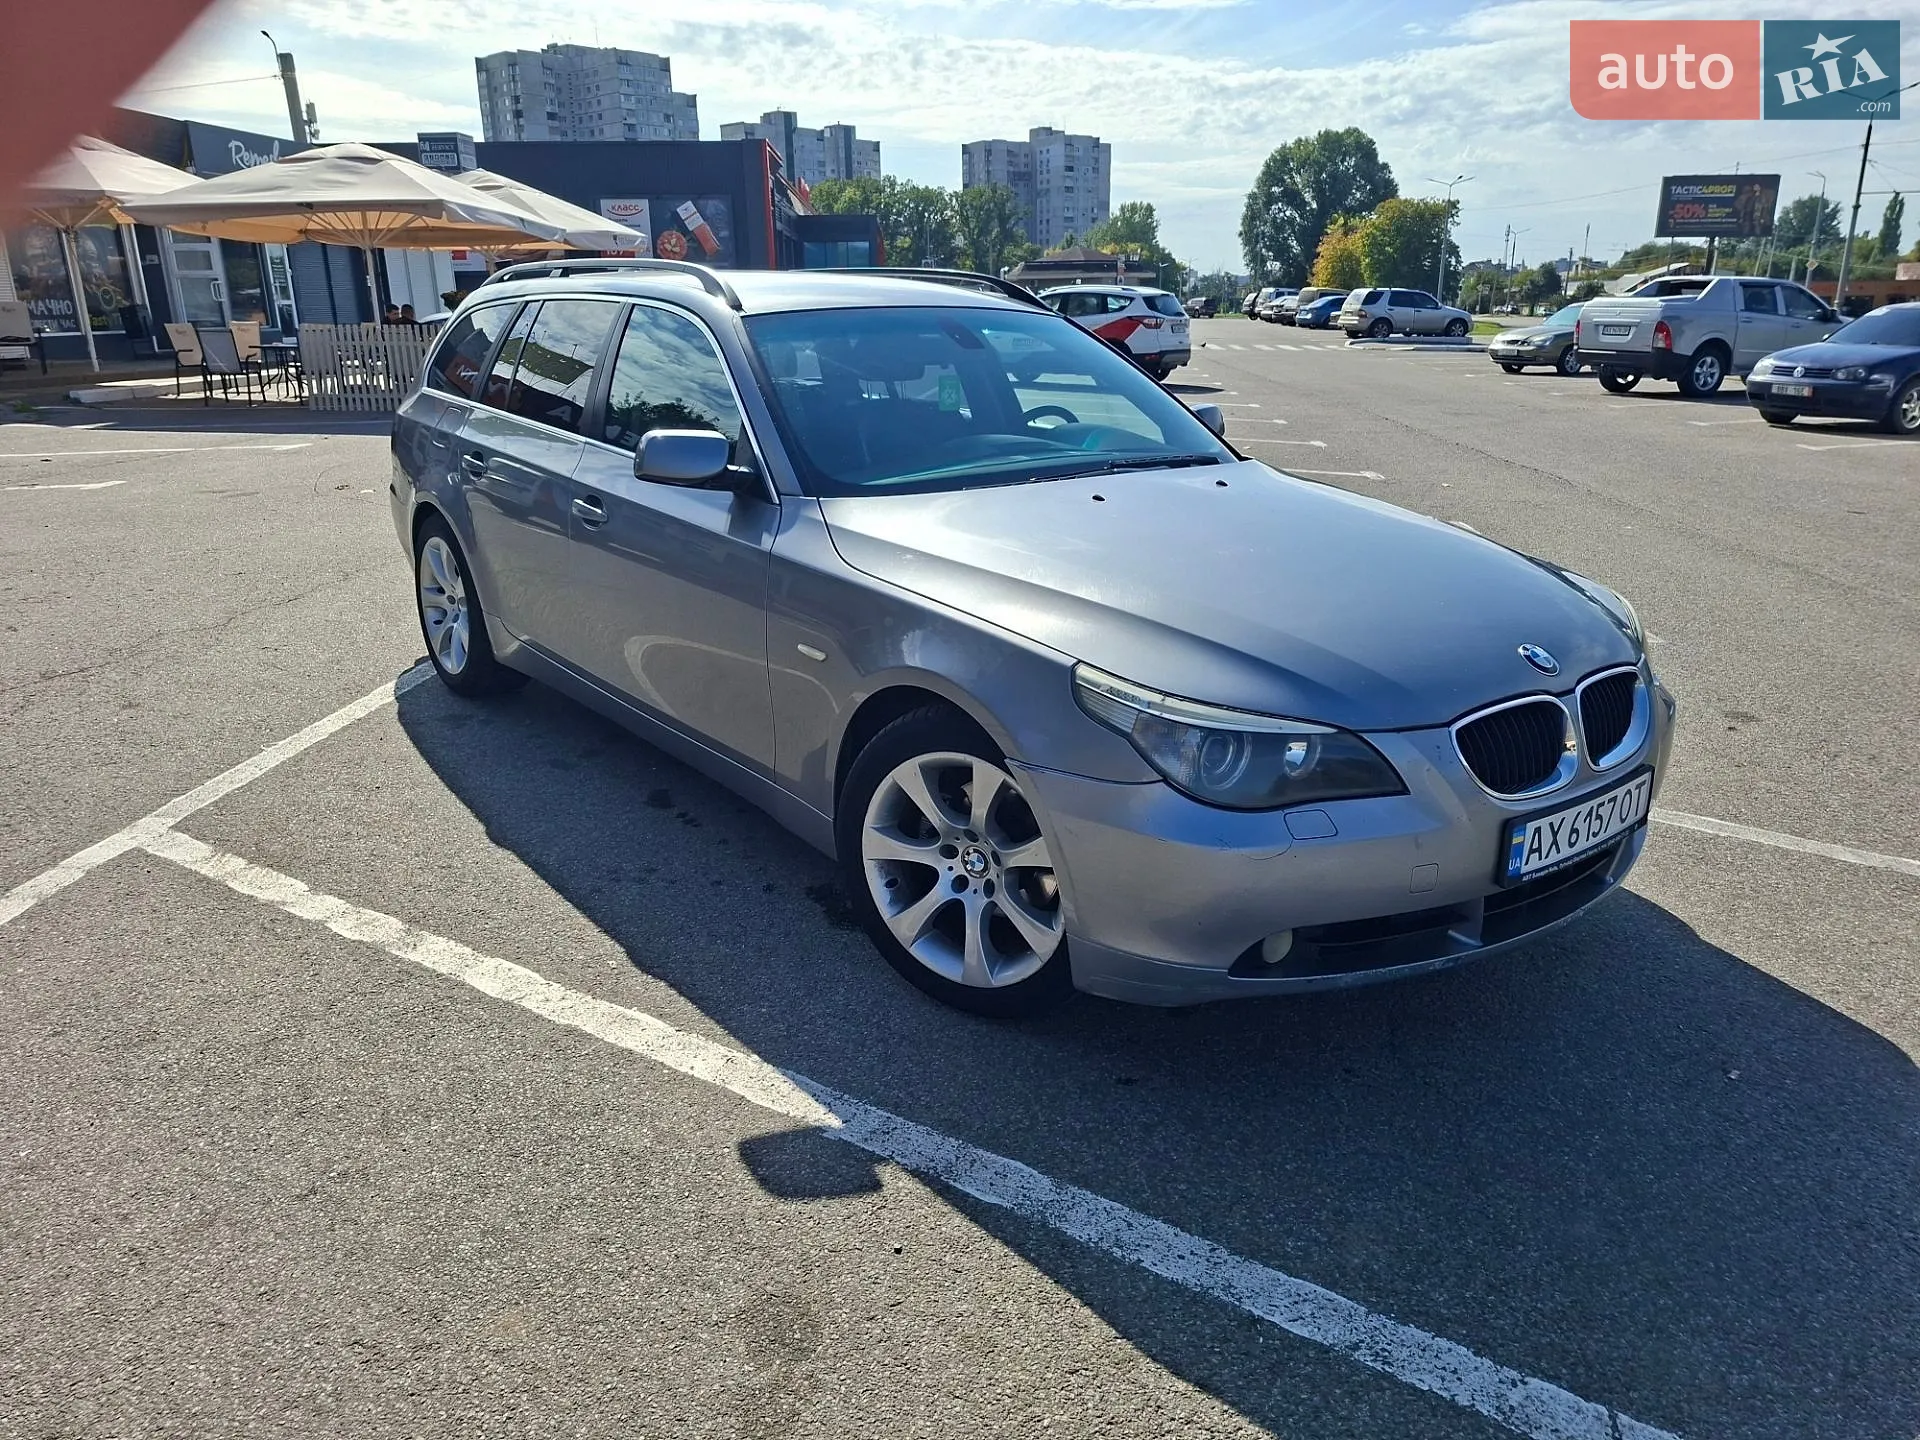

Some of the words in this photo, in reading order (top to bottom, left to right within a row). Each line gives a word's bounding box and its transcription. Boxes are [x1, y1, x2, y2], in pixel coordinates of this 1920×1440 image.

[27, 298, 73, 316] МАЧНО
[1567, 795, 1618, 849] 6157
[1619, 780, 1647, 823] OT
[1508, 857, 1521, 871] UA
